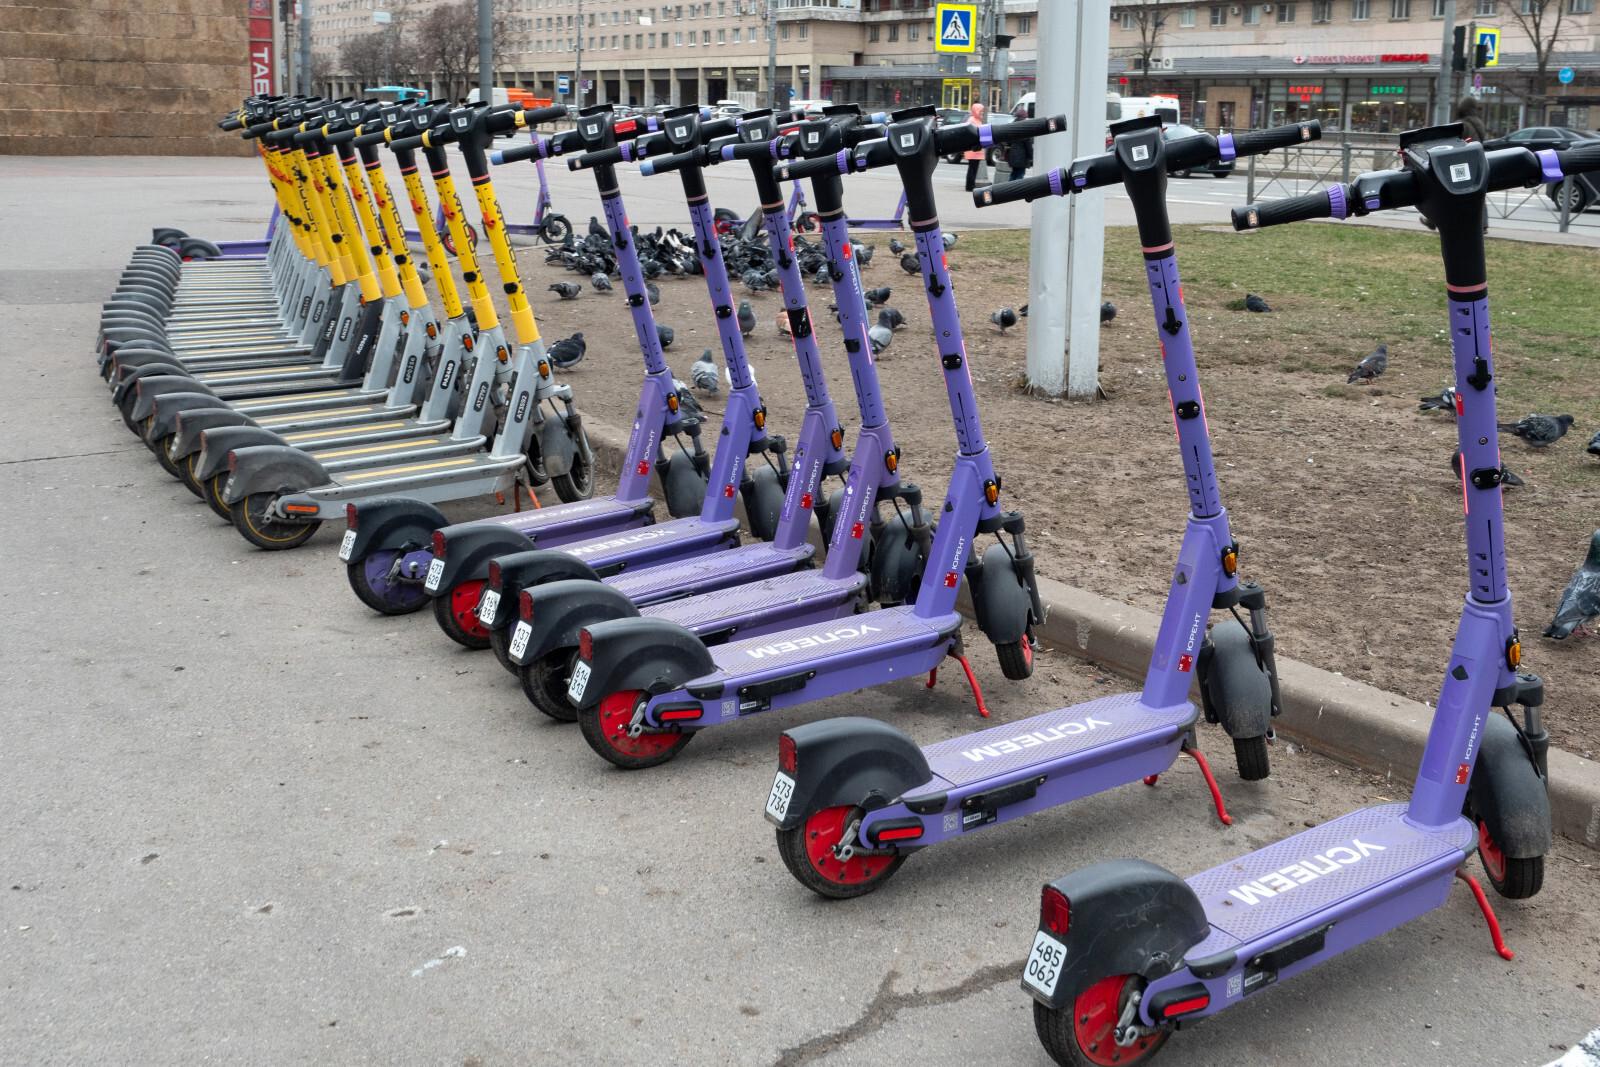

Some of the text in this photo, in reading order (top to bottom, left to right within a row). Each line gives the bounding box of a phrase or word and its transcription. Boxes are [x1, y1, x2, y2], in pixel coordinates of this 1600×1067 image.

[516, 395, 528, 420] AT3592
[730, 455, 741, 483] ЮРЕНТ
[808, 458, 820, 492] ЮРЕНТ
[859, 485, 872, 521] ЮРЕНТ
[951, 535, 965, 570] ЮРЕНТ
[432, 563, 443, 576] 473
[517, 627, 530, 643] 137
[746, 623, 883, 660] УСПЕЕМ
[1186, 611, 1201, 652] ЮРЕНТ
[571, 679, 584, 697] 313
[575, 666, 588, 681] 614
[961, 716, 1113, 762] УСПЕЕМ
[1464, 713, 1481, 760] ЮРЕНТ
[770, 792, 787, 814] 736
[776, 779, 792, 799] 473
[1229, 838, 1388, 907] УСПЕЕМ
[1035, 940, 1063, 968] 485
[1029, 959, 1055, 989] 062
